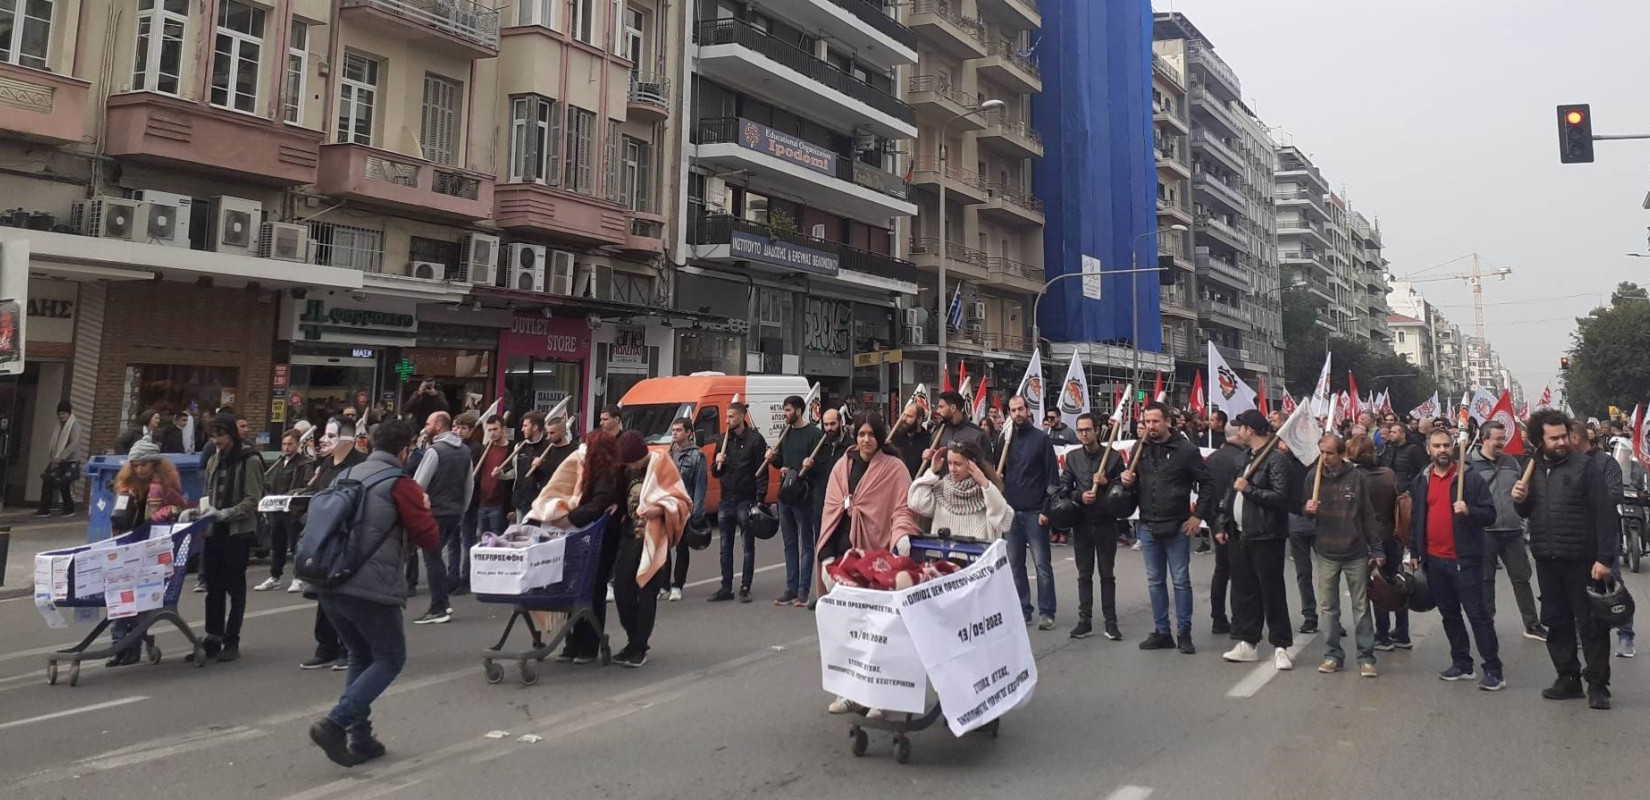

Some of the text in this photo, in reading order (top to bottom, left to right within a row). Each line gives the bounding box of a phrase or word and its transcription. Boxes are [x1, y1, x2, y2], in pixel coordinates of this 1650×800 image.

[765, 129, 831, 160] Educational Organization
[768, 138, 829, 170] Ipodomi
[732, 236, 762, 255] ΙΝΣΤΙΤΟΥΤΟ
[788, 249, 791, 262] &
[511, 316, 550, 335] OUTLET
[547, 334, 577, 352] STORE
[931, 586, 944, 597] ΔΕΝ
[957, 612, 1003, 643] 13/09/2022
